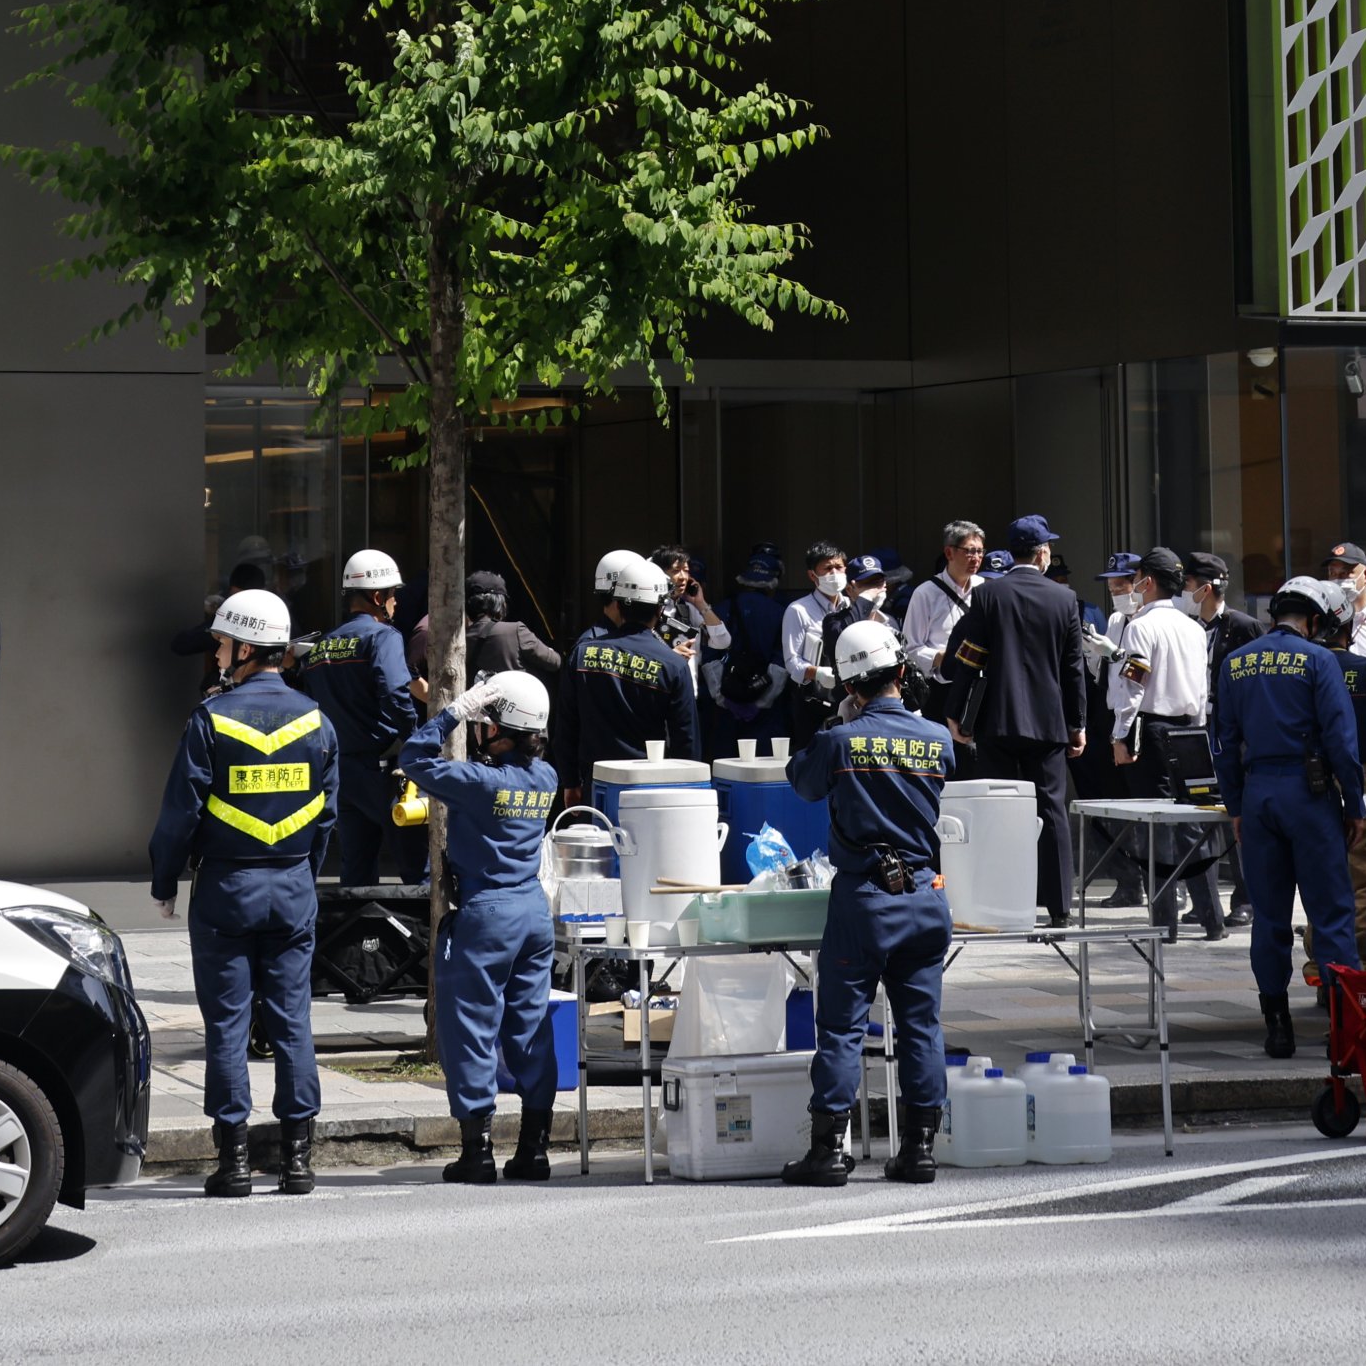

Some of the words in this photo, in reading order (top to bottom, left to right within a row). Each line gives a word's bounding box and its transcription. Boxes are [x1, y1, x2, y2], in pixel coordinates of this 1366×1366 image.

[224, 609, 267, 632] 東京消防庁
[309, 637, 361, 656] 東京消防庁
[583, 659, 613, 670] TOKYO
[613, 665, 632, 676] FIRE
[584, 646, 663, 676] 東京消防庁
[1229, 651, 1308, 673] 東京消防庁
[1230, 667, 1257, 681] TOKYO
[1259, 666, 1278, 676] FIRE
[1281, 666, 1306, 677] DEPT.
[848, 736, 943, 759] 東京消防庁
[851, 754, 889, 766] TOKYO
[890, 756, 913, 768] FIRE
[914, 758, 941, 771] DEPT.
[235, 767, 304, 784] 東京消防庁
[235, 782, 261, 791] TOKYO
[492, 806, 522, 818] TOKYO
[522, 809, 539, 819] FIRE
